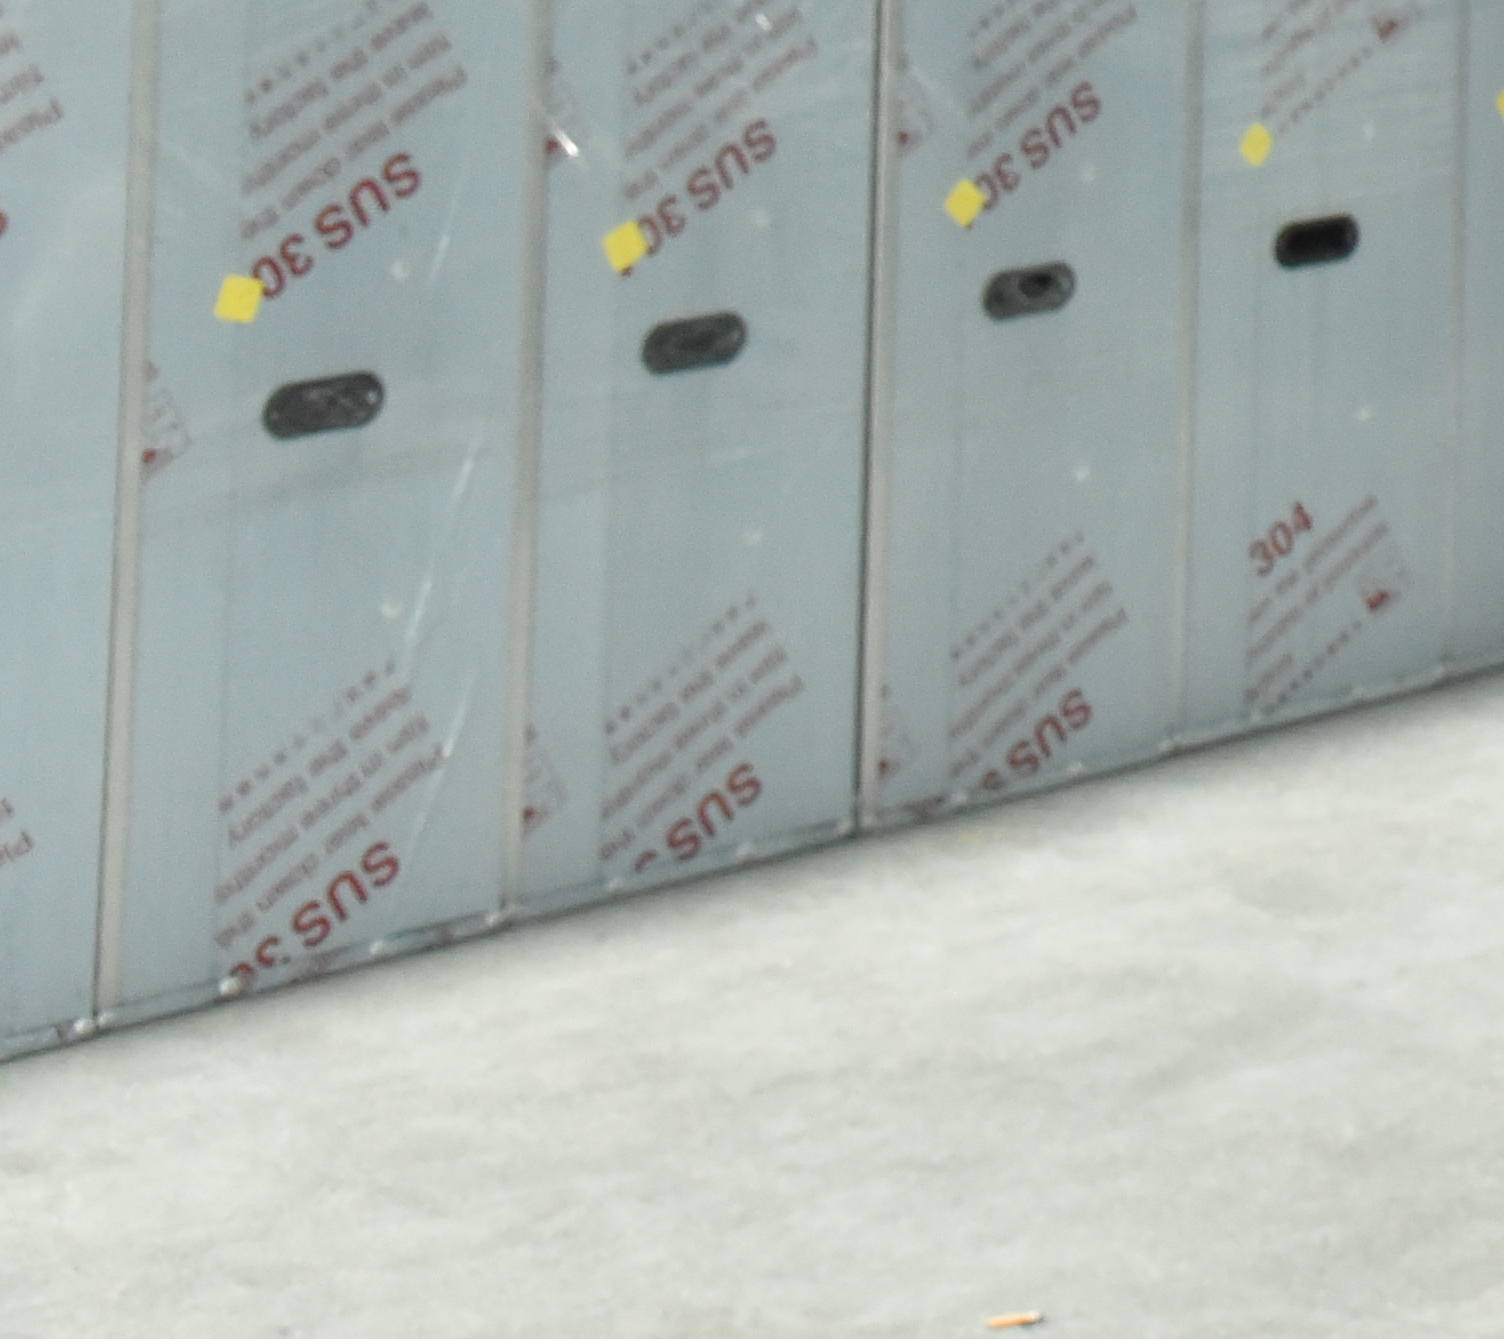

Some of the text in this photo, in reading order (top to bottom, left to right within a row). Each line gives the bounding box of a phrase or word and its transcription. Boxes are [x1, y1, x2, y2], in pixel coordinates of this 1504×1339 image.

[688, 121, 776, 210] SUS
[1022, 81, 1102, 169] SUS
[253, 152, 422, 299] SUS 30
[1249, 501, 1313, 576] 304
[1008, 689, 1092, 777] SUS
[667, 763, 762, 860] SUS
[292, 841, 400, 947] SUS
